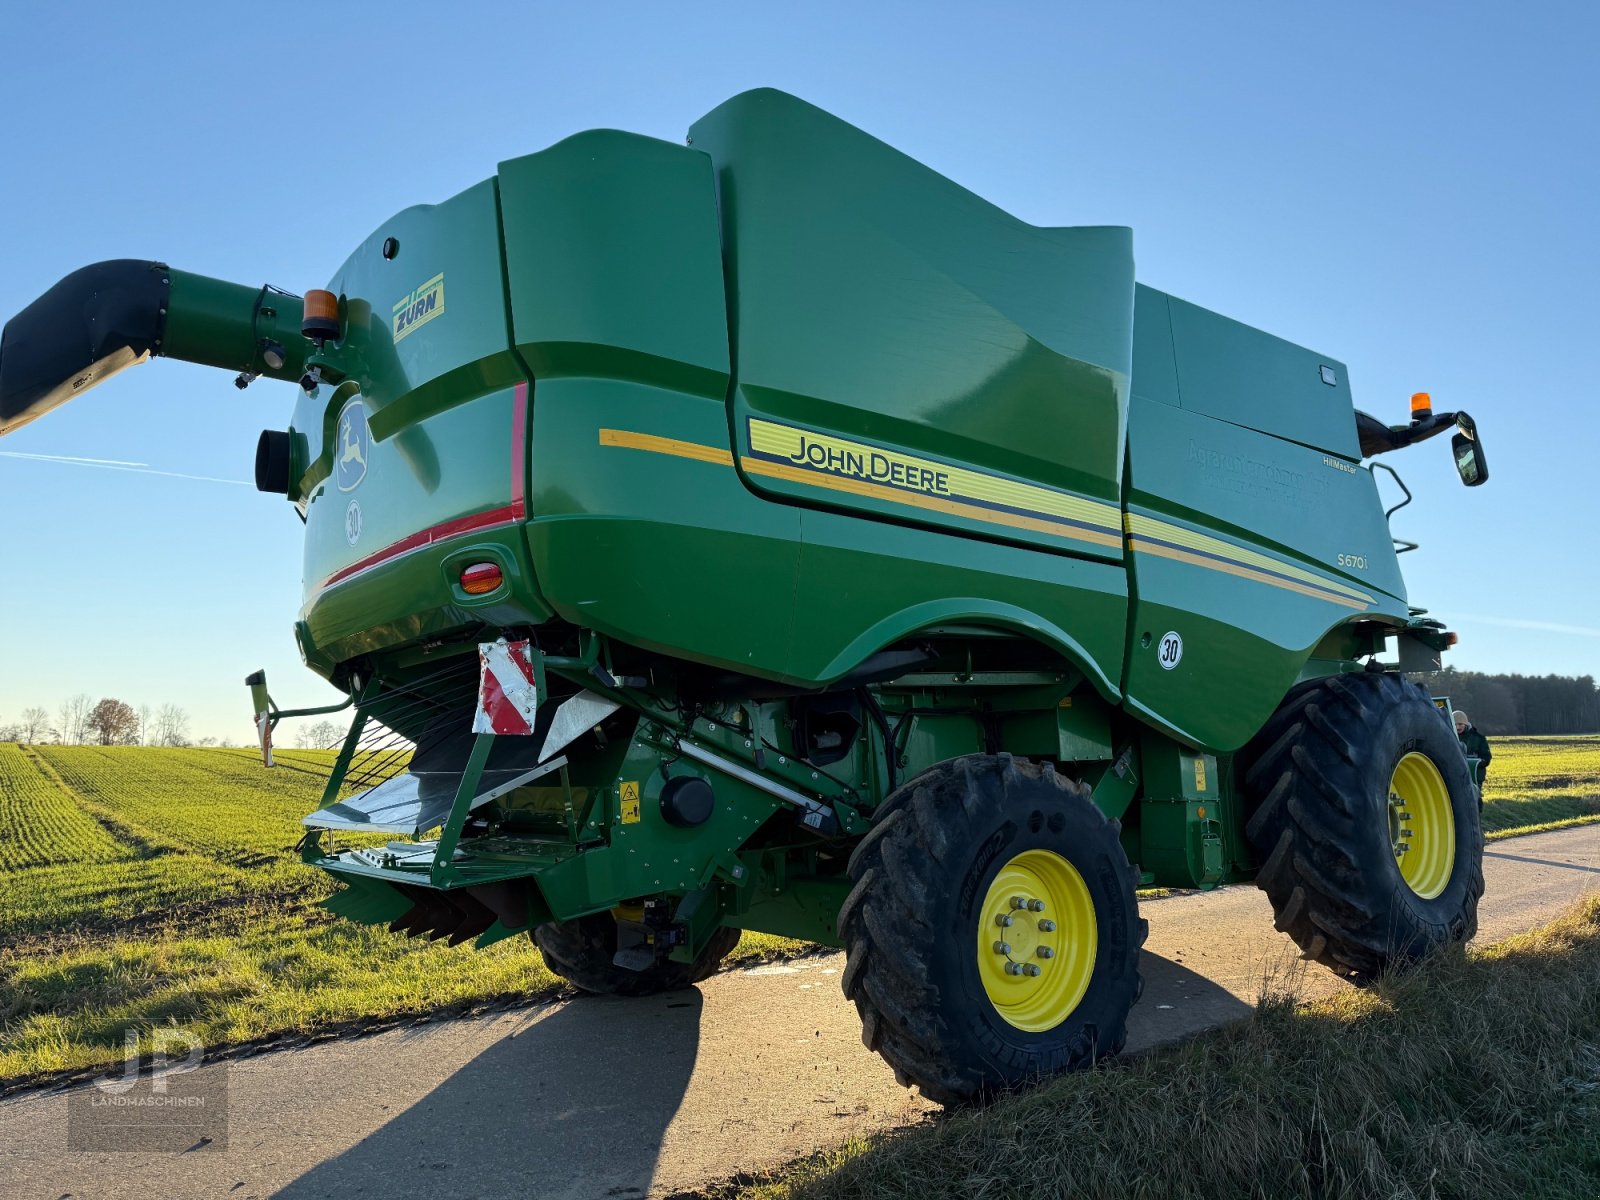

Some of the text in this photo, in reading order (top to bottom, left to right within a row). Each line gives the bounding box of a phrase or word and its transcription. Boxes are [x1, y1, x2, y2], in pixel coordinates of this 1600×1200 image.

[790, 436, 949, 493] JOHN DEERE
[1323, 456, 1357, 474] HillMaster
[348, 507, 359, 539] 30
[1162, 638, 1178, 662] 30
